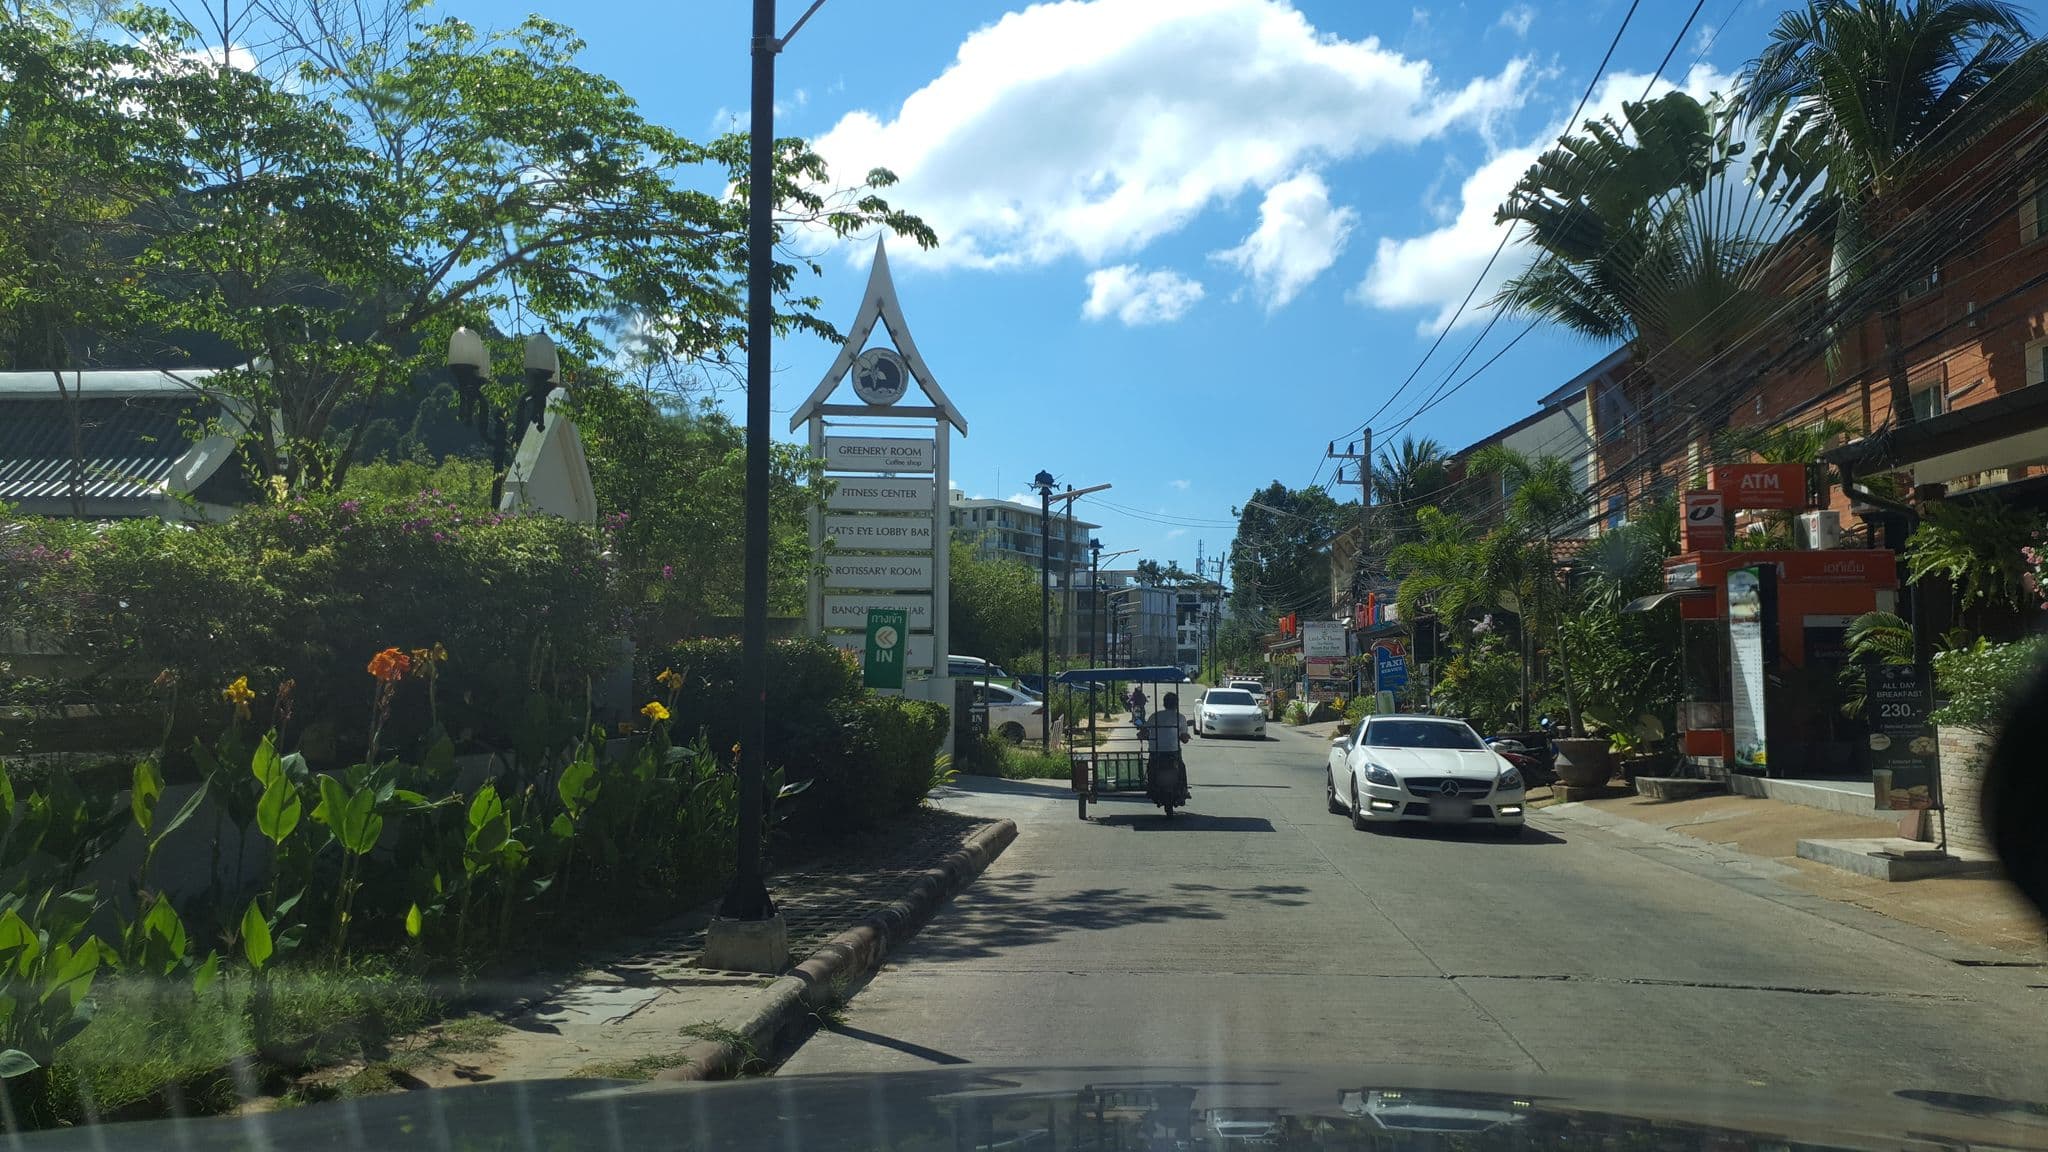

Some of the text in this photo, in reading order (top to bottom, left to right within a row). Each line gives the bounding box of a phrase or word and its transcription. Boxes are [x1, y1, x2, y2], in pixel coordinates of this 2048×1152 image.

[839, 446, 922, 456] GREENERY ROOM
[907, 459, 922, 467] shop
[1741, 474, 1779, 489] ATM
[842, 488, 917, 498] FITNESS CENTER
[827, 526, 930, 537] CAT'S EYE LOBBY BAR
[835, 567, 922, 576] ROTISSARY ROOM
[876, 650, 893, 662] IN
[1379, 659, 1403, 668] TAXI
[1900, 681, 1916, 689] DAY
[1877, 690, 1923, 698] BREAKFAST
[971, 714, 983, 723] IN
